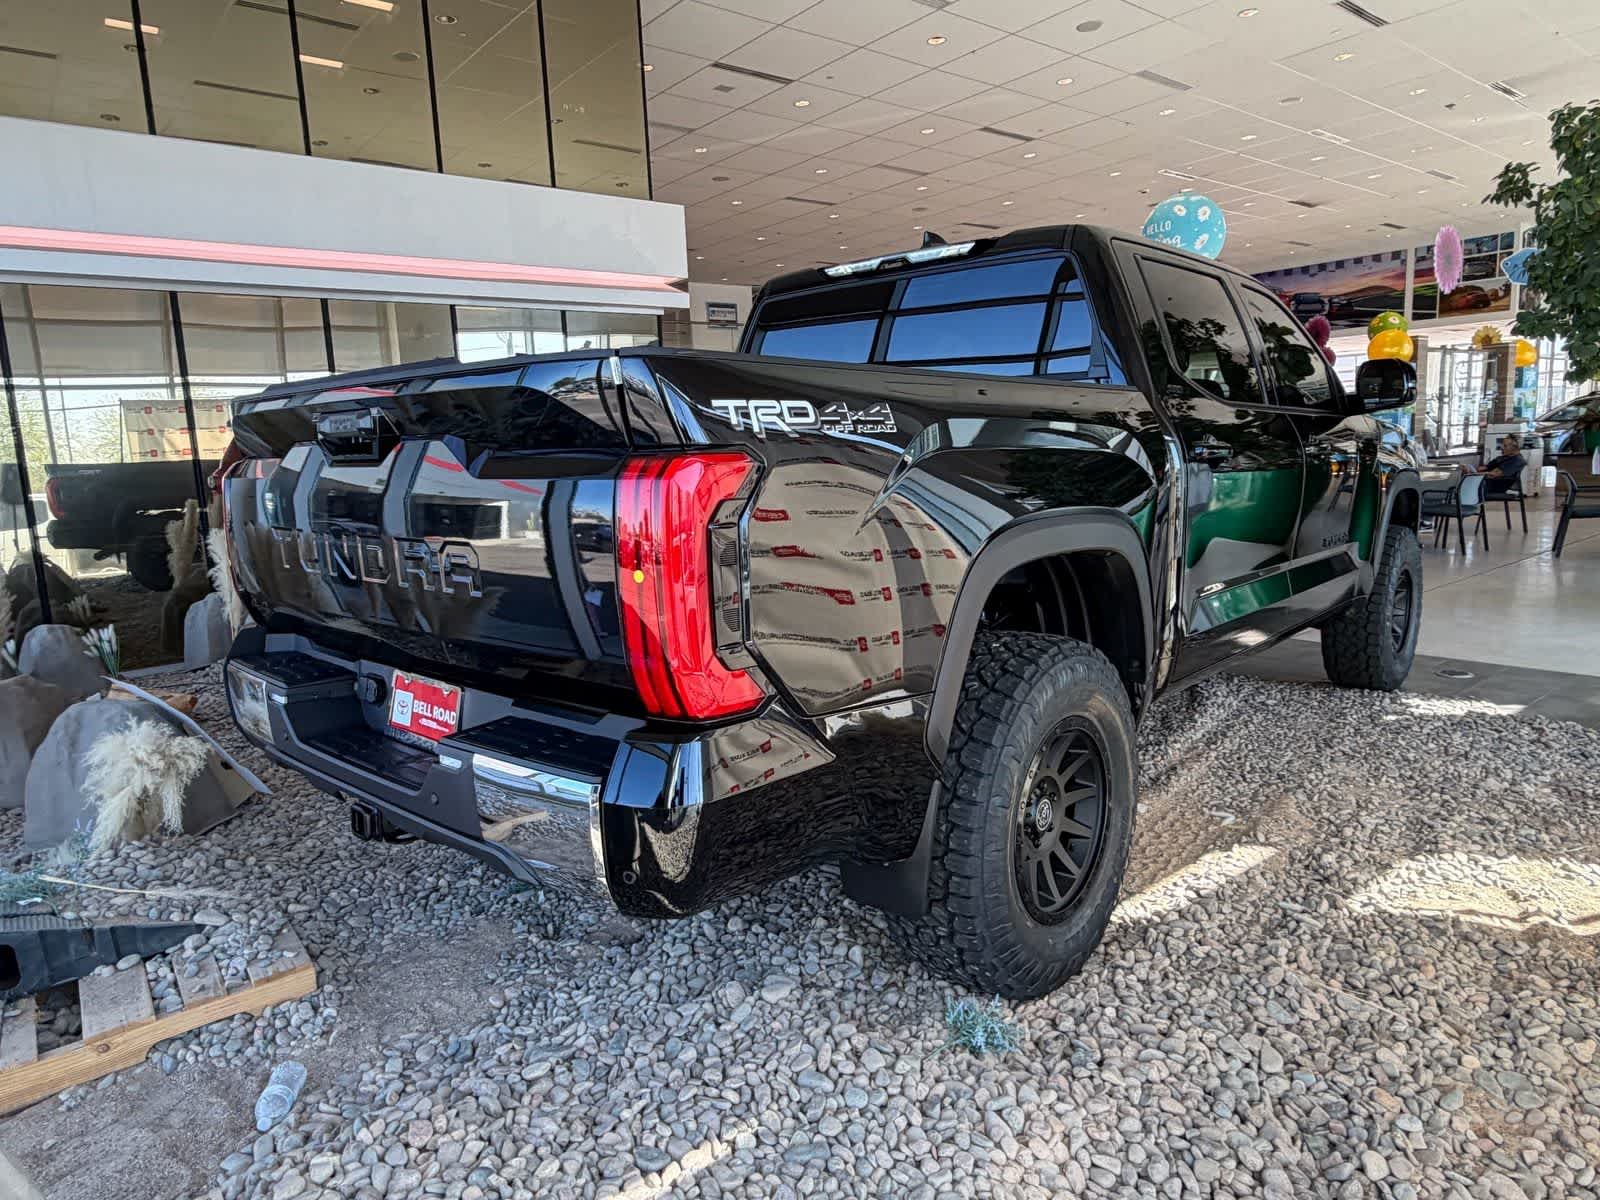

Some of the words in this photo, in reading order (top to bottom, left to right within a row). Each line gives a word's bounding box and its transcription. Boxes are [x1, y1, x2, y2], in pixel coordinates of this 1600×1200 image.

[711, 399, 818, 438] TRD
[857, 424, 897, 433] ROAD
[271, 526, 484, 598] TUNDRA
[413, 700, 432, 717] BELL
[433, 706, 456, 725] ROAD
